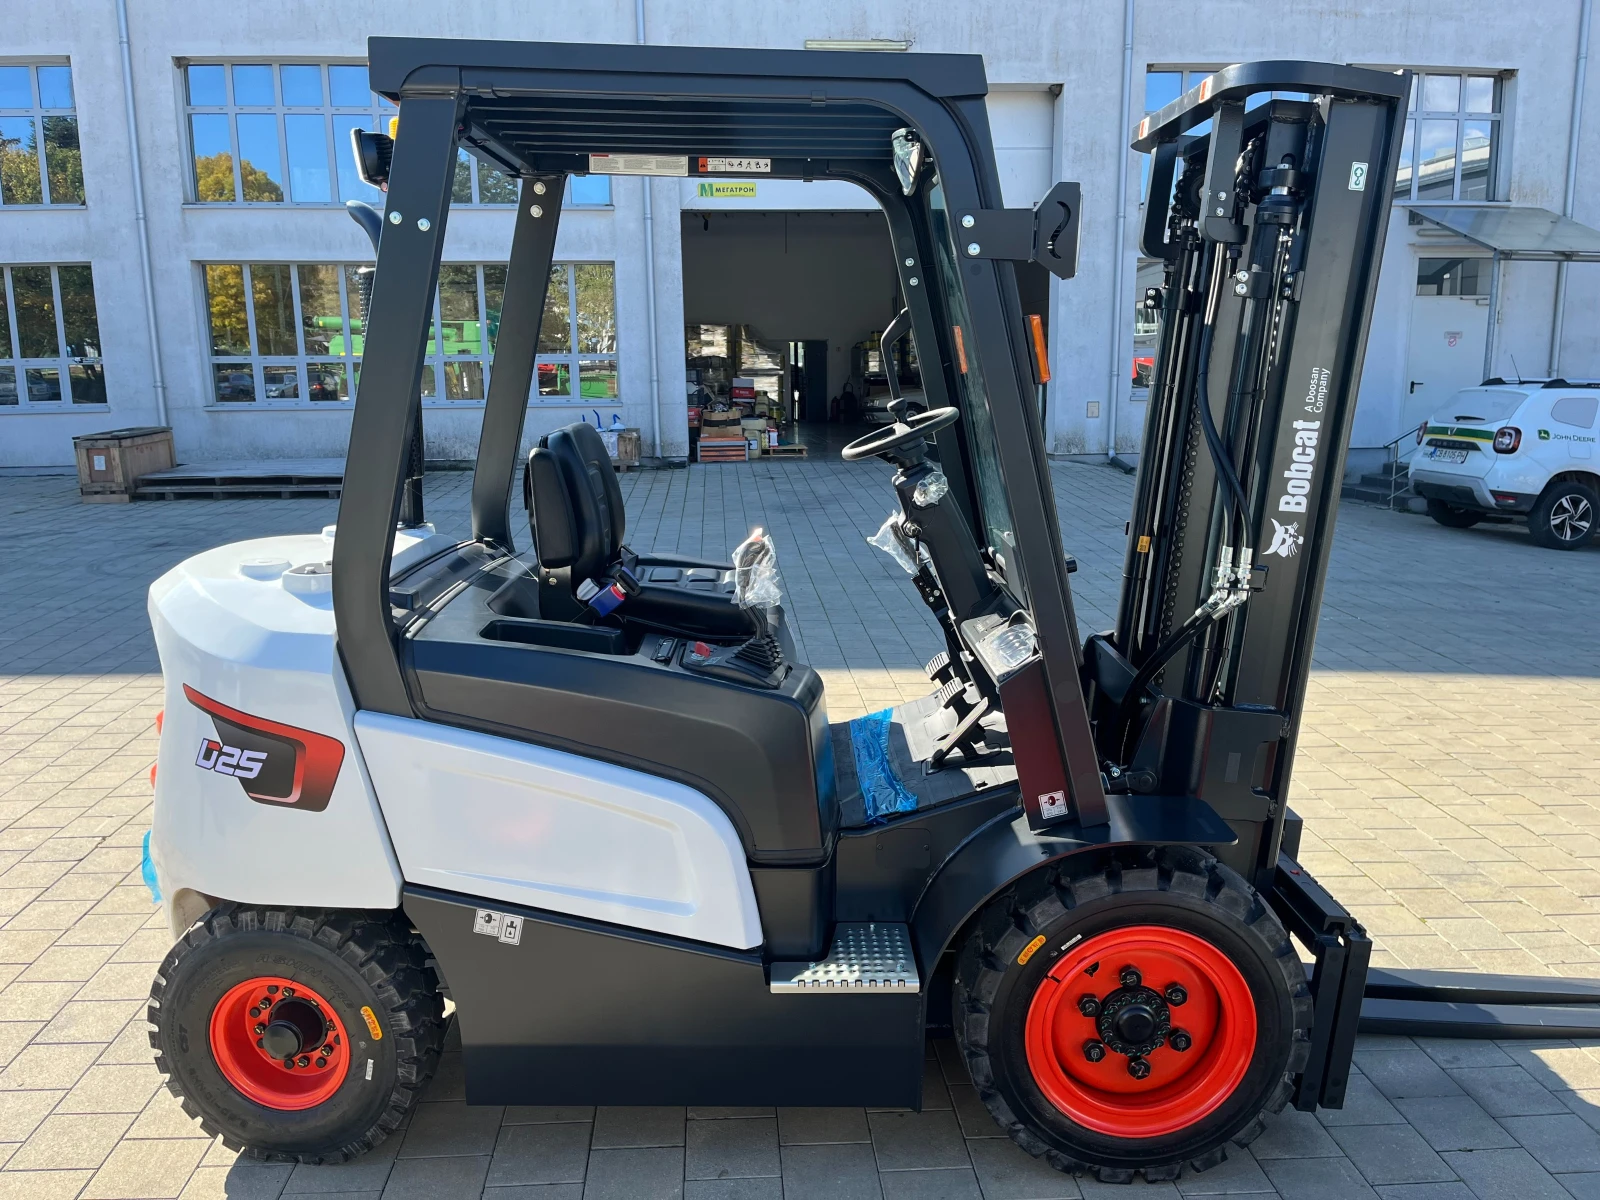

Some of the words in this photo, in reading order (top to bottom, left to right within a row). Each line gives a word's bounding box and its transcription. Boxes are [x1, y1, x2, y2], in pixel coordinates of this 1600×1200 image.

[1305, 367, 1320, 403] Doosan
[1313, 368, 1331, 413] Company
[1304, 405, 1314, 413] A
[1552, 433, 1572, 441] JOHN
[1572, 434, 1596, 443] DEERE
[1278, 419, 1321, 513] Bobcat
